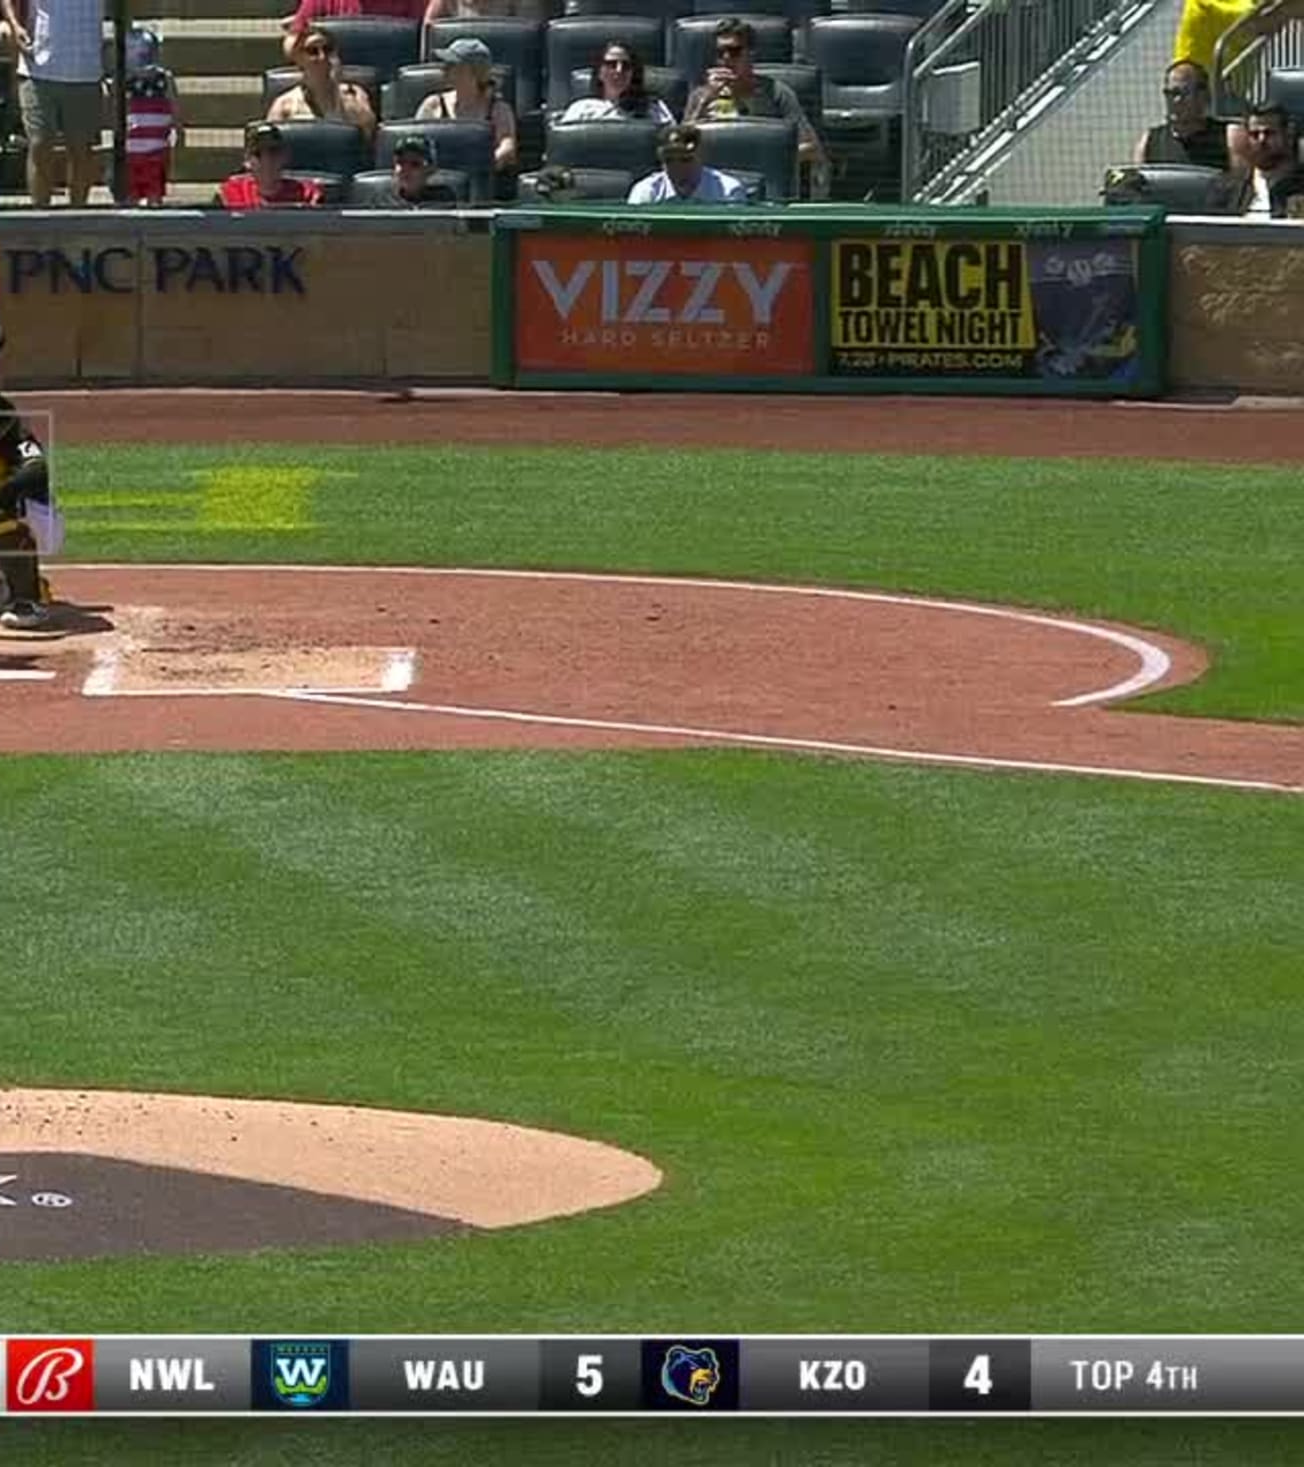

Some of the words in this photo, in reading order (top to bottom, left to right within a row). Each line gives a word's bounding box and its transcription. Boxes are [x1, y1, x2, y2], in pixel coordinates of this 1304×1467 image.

[6, 247, 135, 293] PNC
[149, 246, 307, 296] PARK
[531, 259, 792, 325] VIZZY
[838, 243, 1023, 310] BEACH
[561, 328, 637, 347] HARD
[652, 329, 770, 348] SELTZER
[839, 310, 929, 344] TOWEL
[935, 311, 1022, 345] NIGHT
